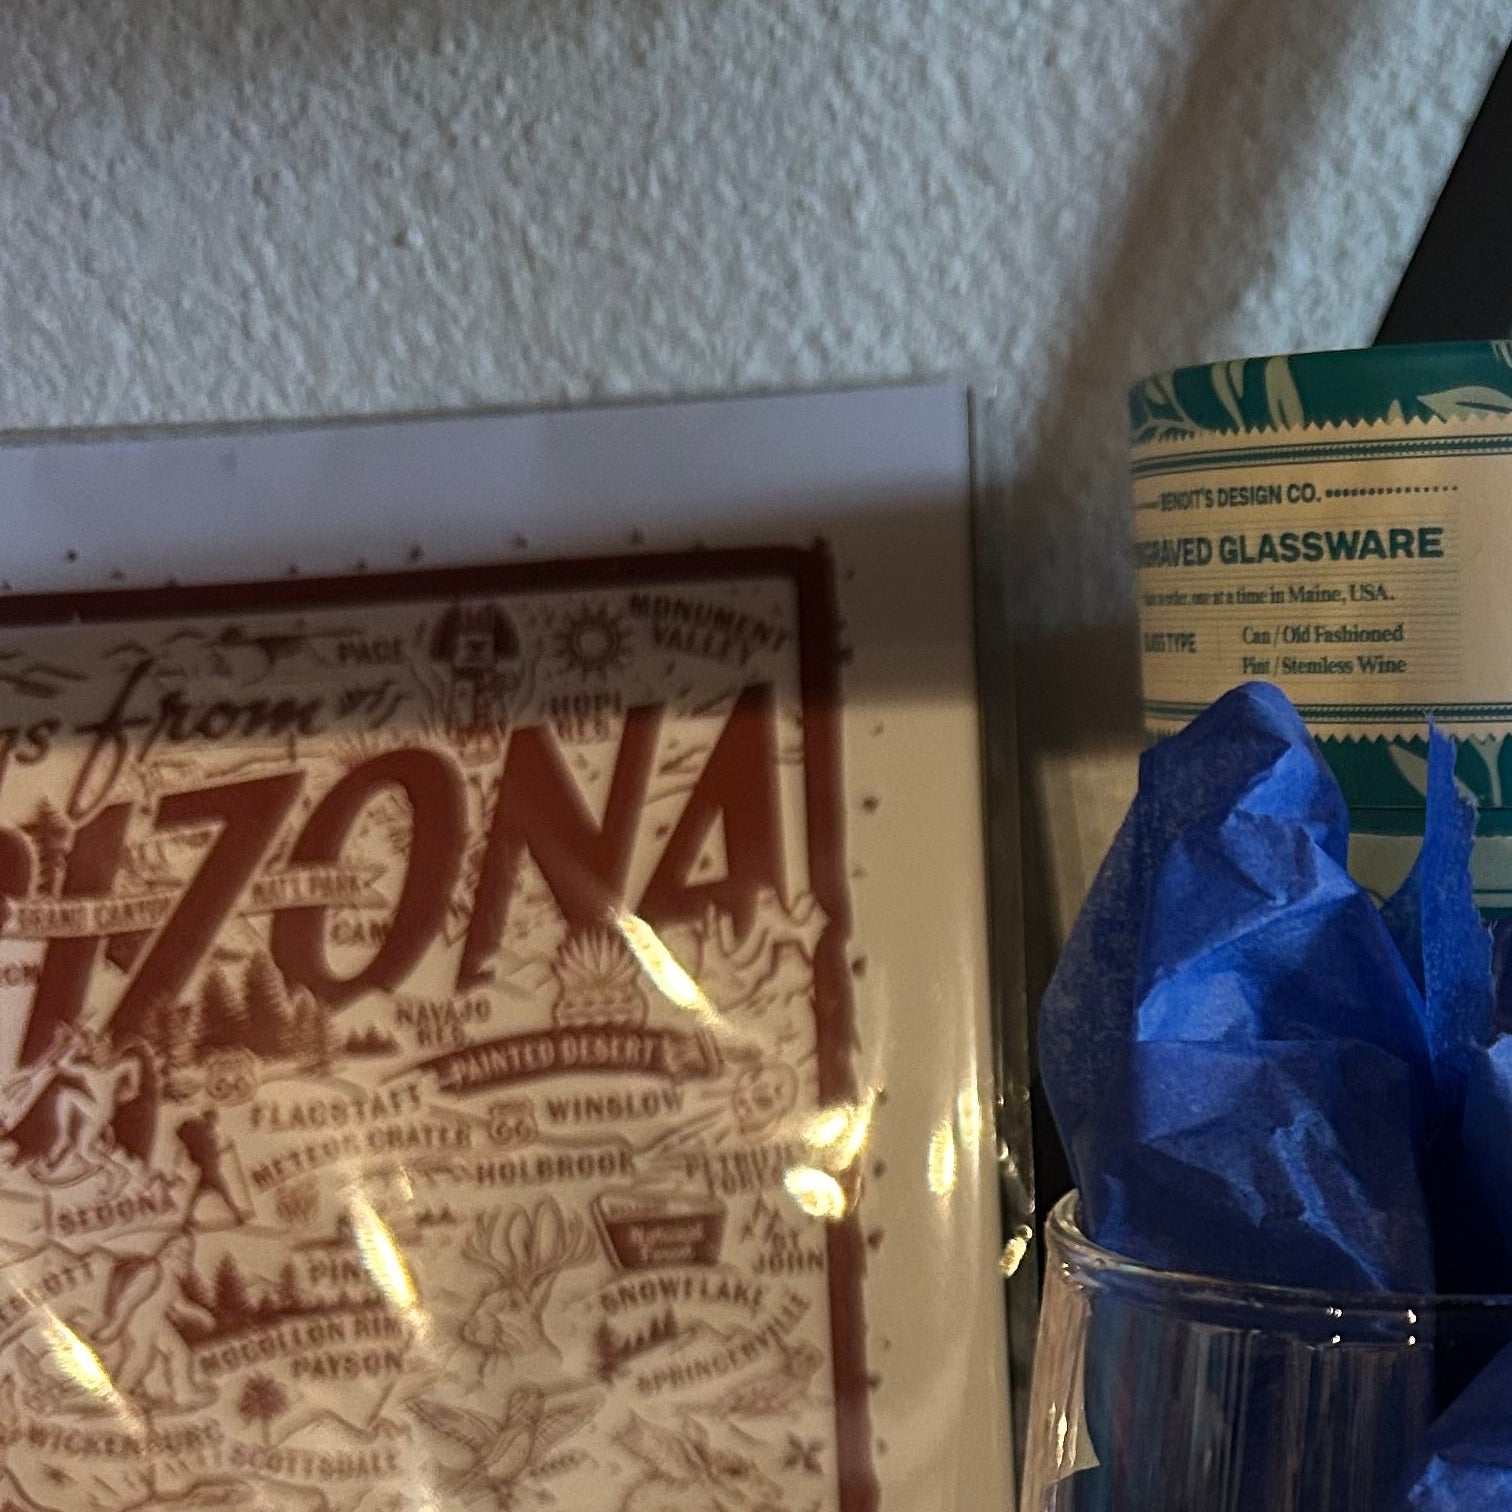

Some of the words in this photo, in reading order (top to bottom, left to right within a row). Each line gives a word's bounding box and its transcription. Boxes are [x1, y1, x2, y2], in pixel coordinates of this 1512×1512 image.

[1217, 484, 1282, 508] DESIGN
[1286, 482, 1323, 503] CO.
[1219, 526, 1446, 565] GLASSWARE
[1236, 585, 1265, 603] time
[1269, 585, 1285, 602] in
[1288, 584, 1346, 605] Maine,
[1350, 582, 1395, 602] USA.
[1241, 624, 1271, 645] Can
[1282, 621, 1311, 644] Old
[1313, 620, 1404, 643] Fashioned
[1241, 654, 1271, 675] Pint
[1281, 653, 1354, 675] Stemless
[1357, 651, 1408, 674] Wine
[67, 654, 324, 823] from
[0, 681, 796, 1070] IZONA
[449, 1037, 556, 1085] PAINTED
[559, 1033, 657, 1068] DESERT
[249, 1078, 424, 1128] FLAGSTAFF
[544, 1087, 685, 1125] WINSLOW
[365, 1121, 473, 1150] CRATER
[475, 1146, 635, 1188] HOLBROOK
[56, 1185, 178, 1237] SEDONA
[599, 1274, 764, 1317] SNOWFLAKE
[289, 1346, 404, 1380] PAYSON
[227, 1446, 398, 1482] SCOTTSDALE
